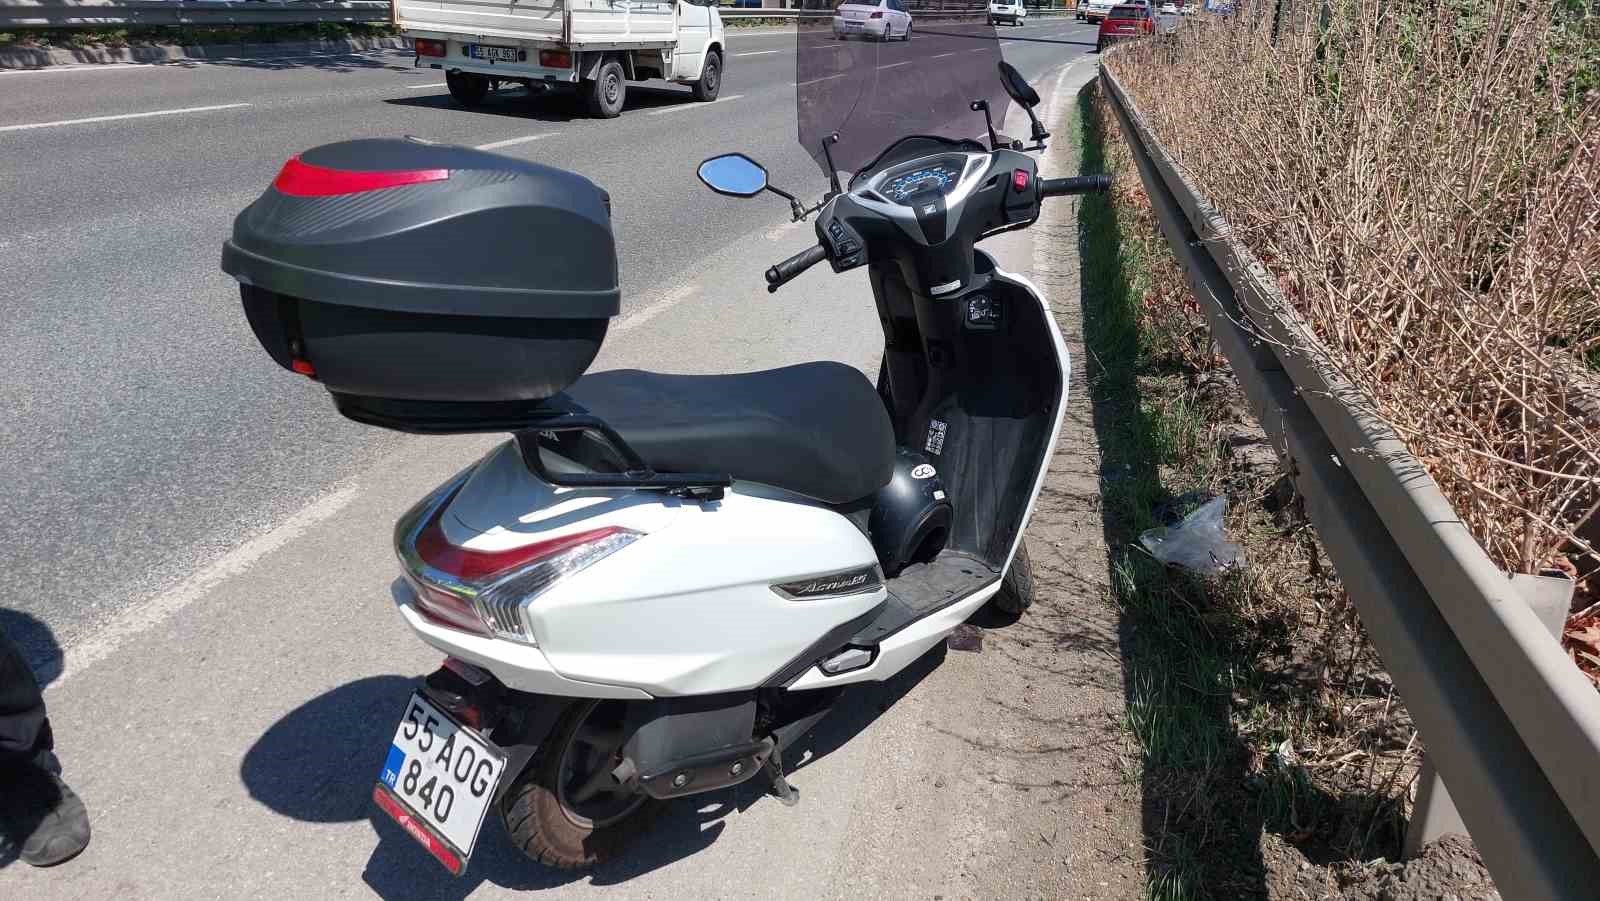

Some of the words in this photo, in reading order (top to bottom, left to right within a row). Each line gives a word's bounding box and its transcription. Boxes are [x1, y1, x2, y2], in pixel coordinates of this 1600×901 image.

[385, 769, 396, 785] TR
[404, 703, 439, 752] 55
[436, 735, 493, 797] AOG
[403, 759, 454, 823] 840
